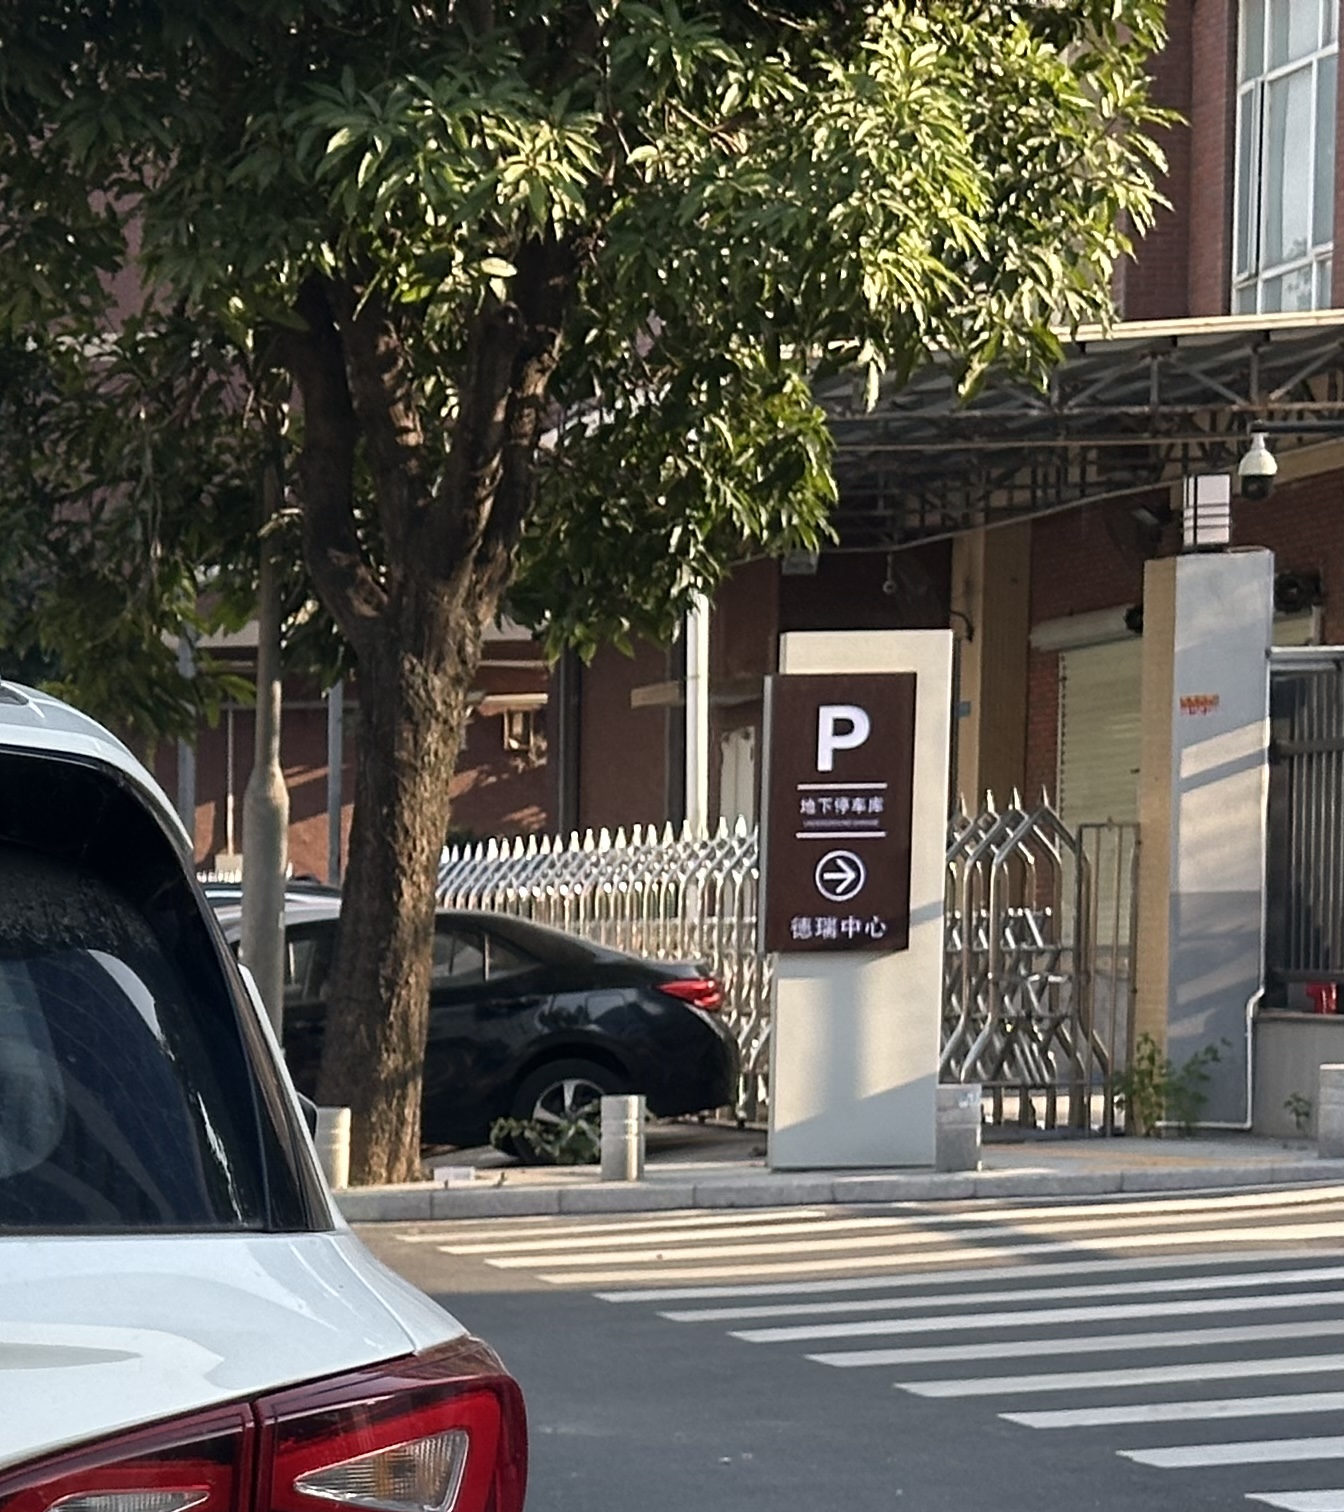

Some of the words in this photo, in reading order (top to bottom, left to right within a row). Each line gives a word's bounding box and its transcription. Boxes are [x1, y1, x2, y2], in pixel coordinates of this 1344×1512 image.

[816, 704, 871, 773] P
[800, 796, 884, 815] 地下停车库
[791, 915, 886, 940] 德瑞中心
